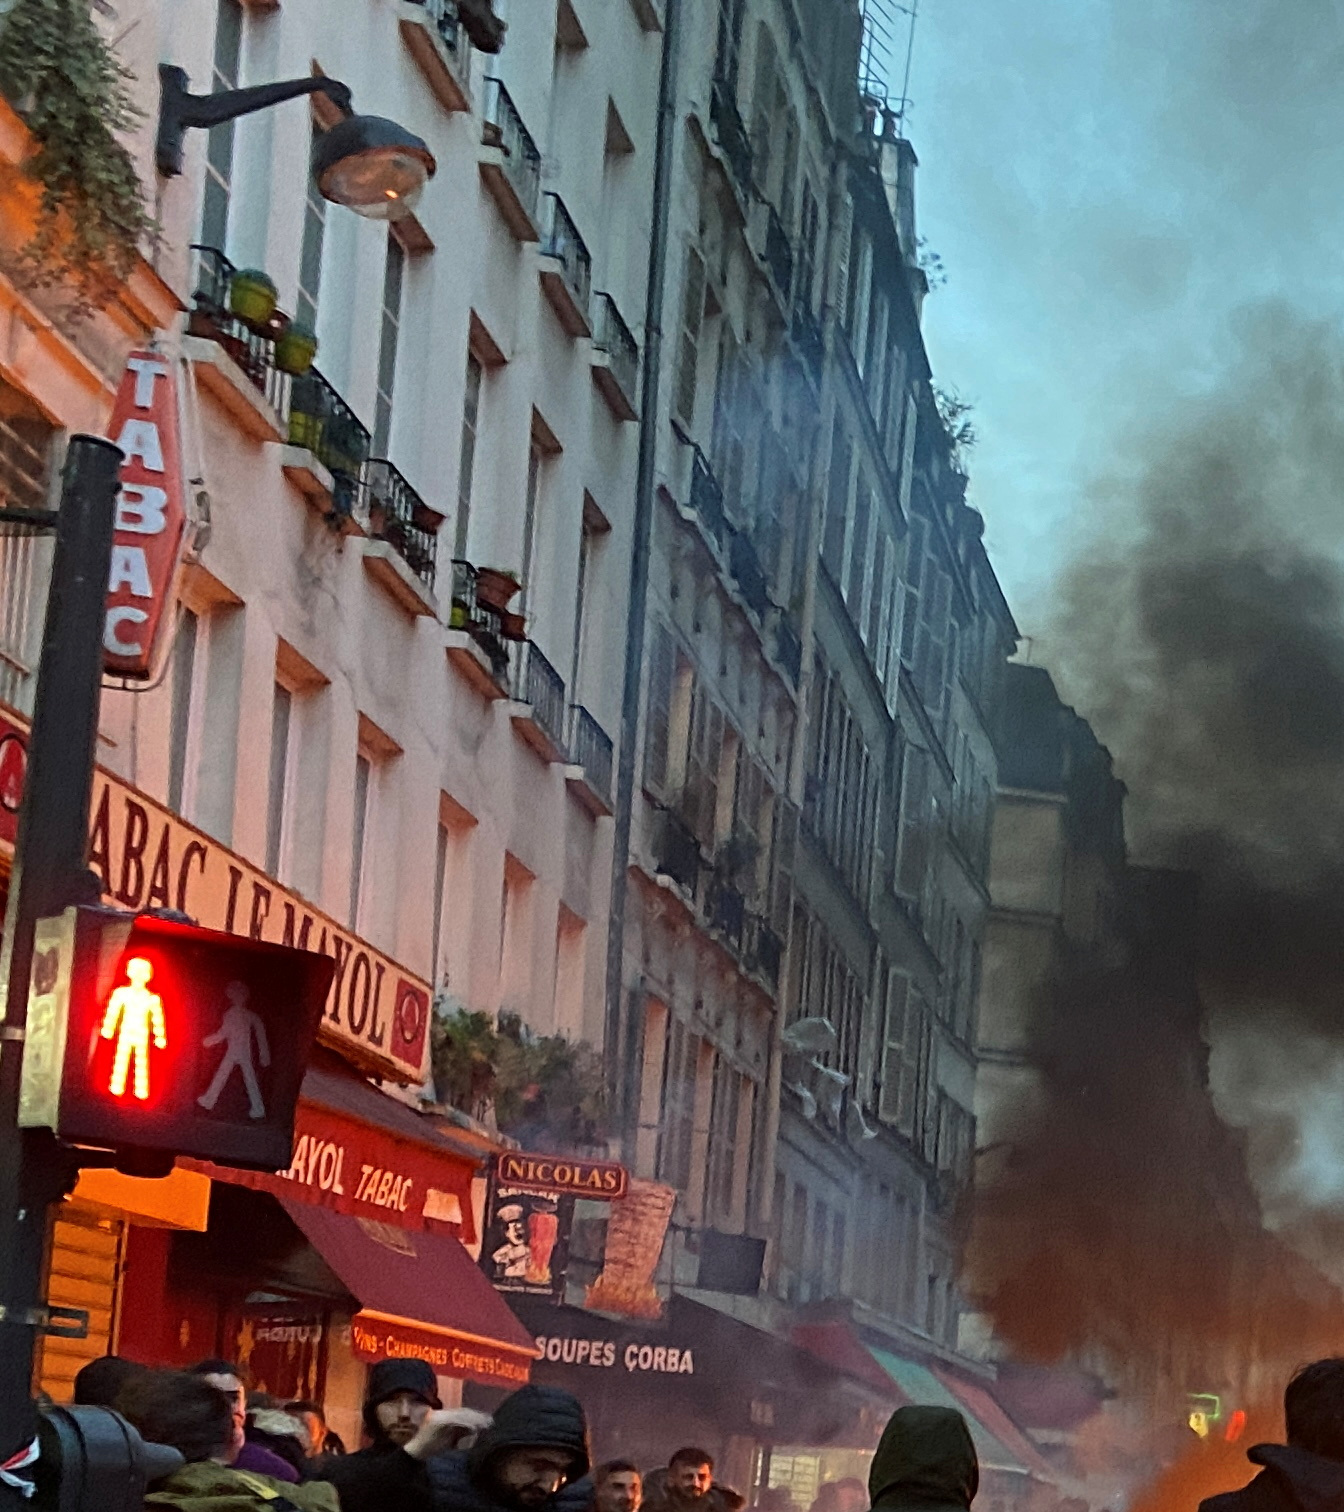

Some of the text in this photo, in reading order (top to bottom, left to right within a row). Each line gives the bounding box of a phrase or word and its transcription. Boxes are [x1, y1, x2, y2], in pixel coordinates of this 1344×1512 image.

[103, 357, 167, 656] TABAC
[89, 783, 207, 920] ABAC
[275, 1134, 413, 1212] AYOL TABAC
[507, 1159, 617, 1190] NICOLAS
[535, 1336, 694, 1375] SOUPES ÇORBA
